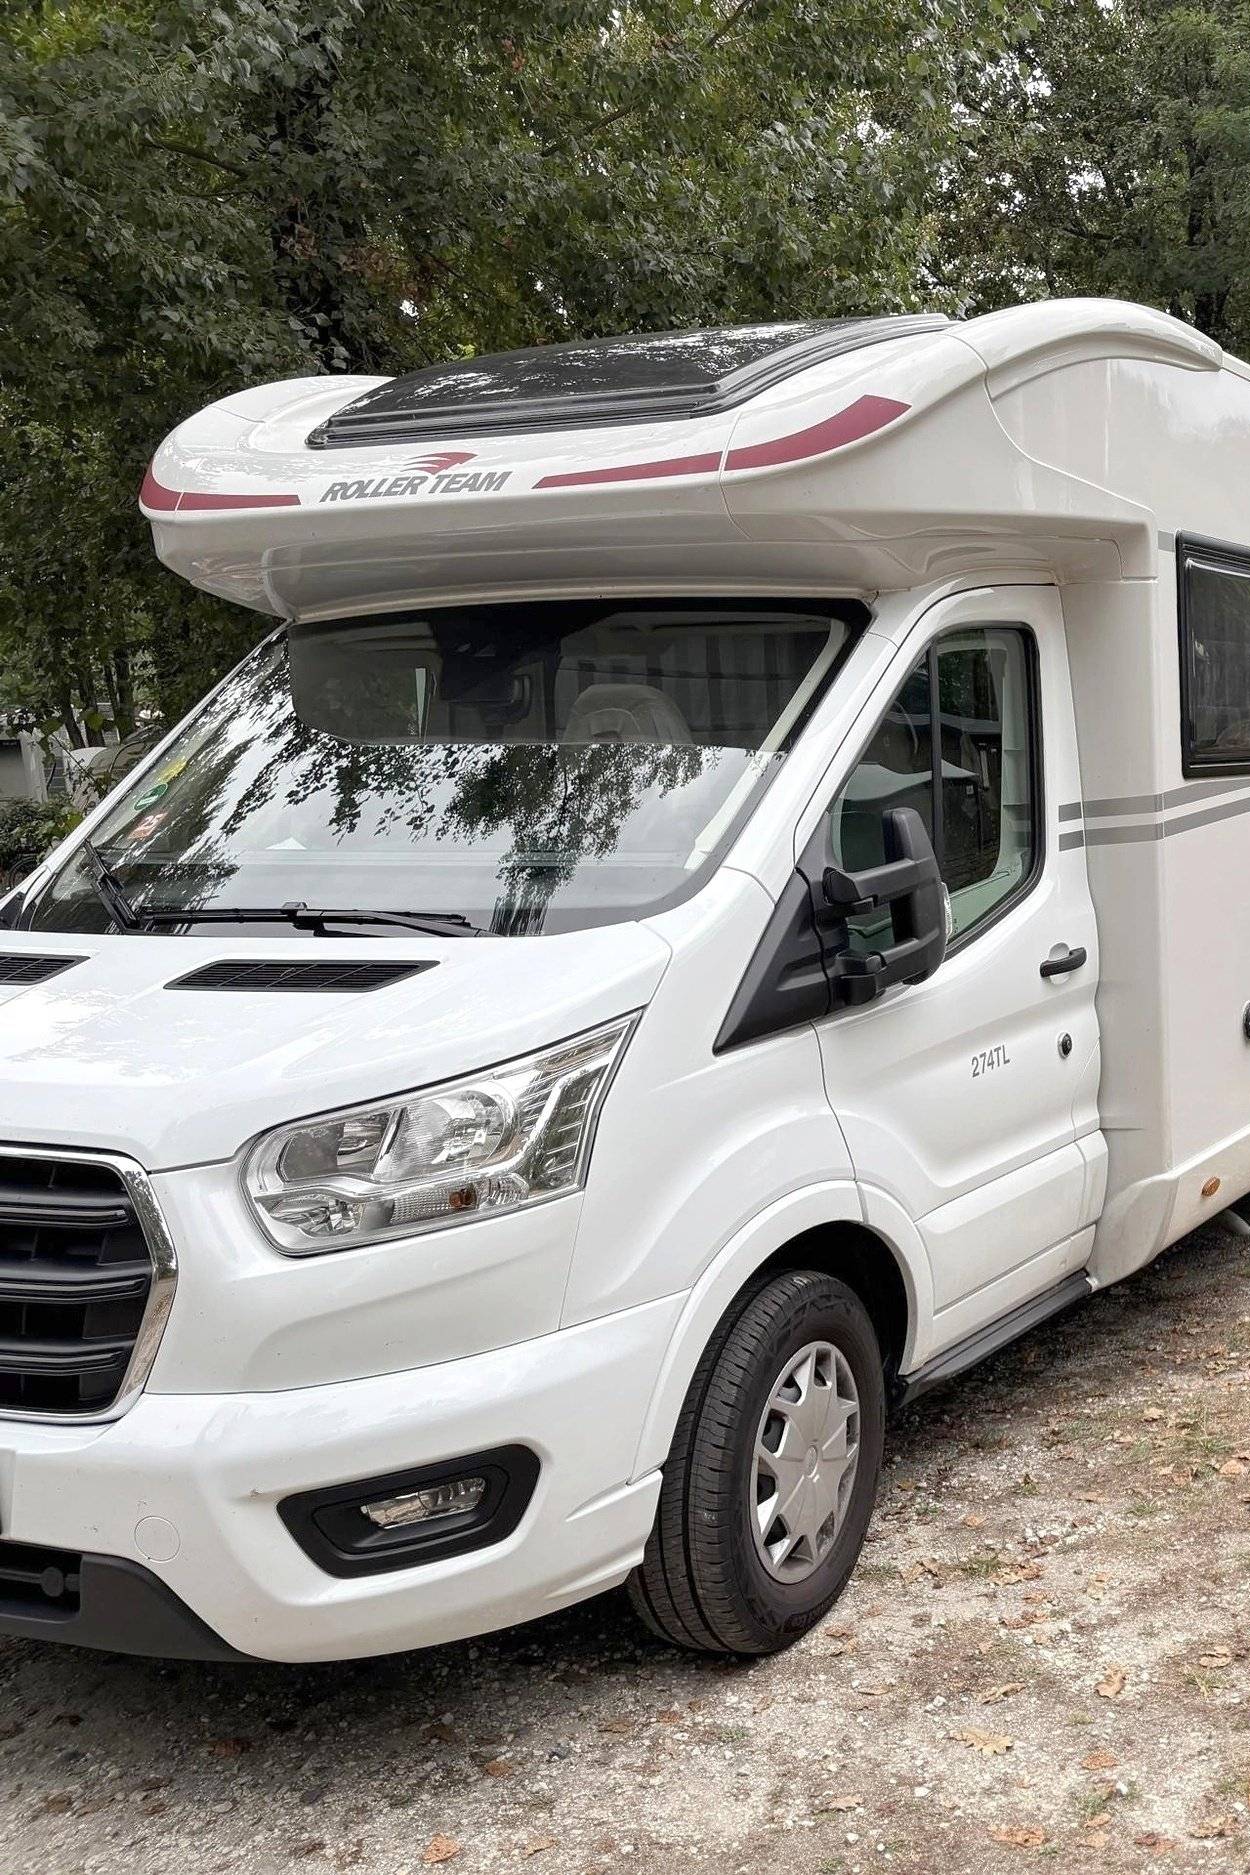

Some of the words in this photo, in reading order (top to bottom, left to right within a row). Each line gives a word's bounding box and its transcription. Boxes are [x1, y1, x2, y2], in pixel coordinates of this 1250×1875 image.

[319, 475, 429, 503] ROLLER
[428, 471, 513, 494] TEAM
[971, 1044, 1011, 1078] 274TL
